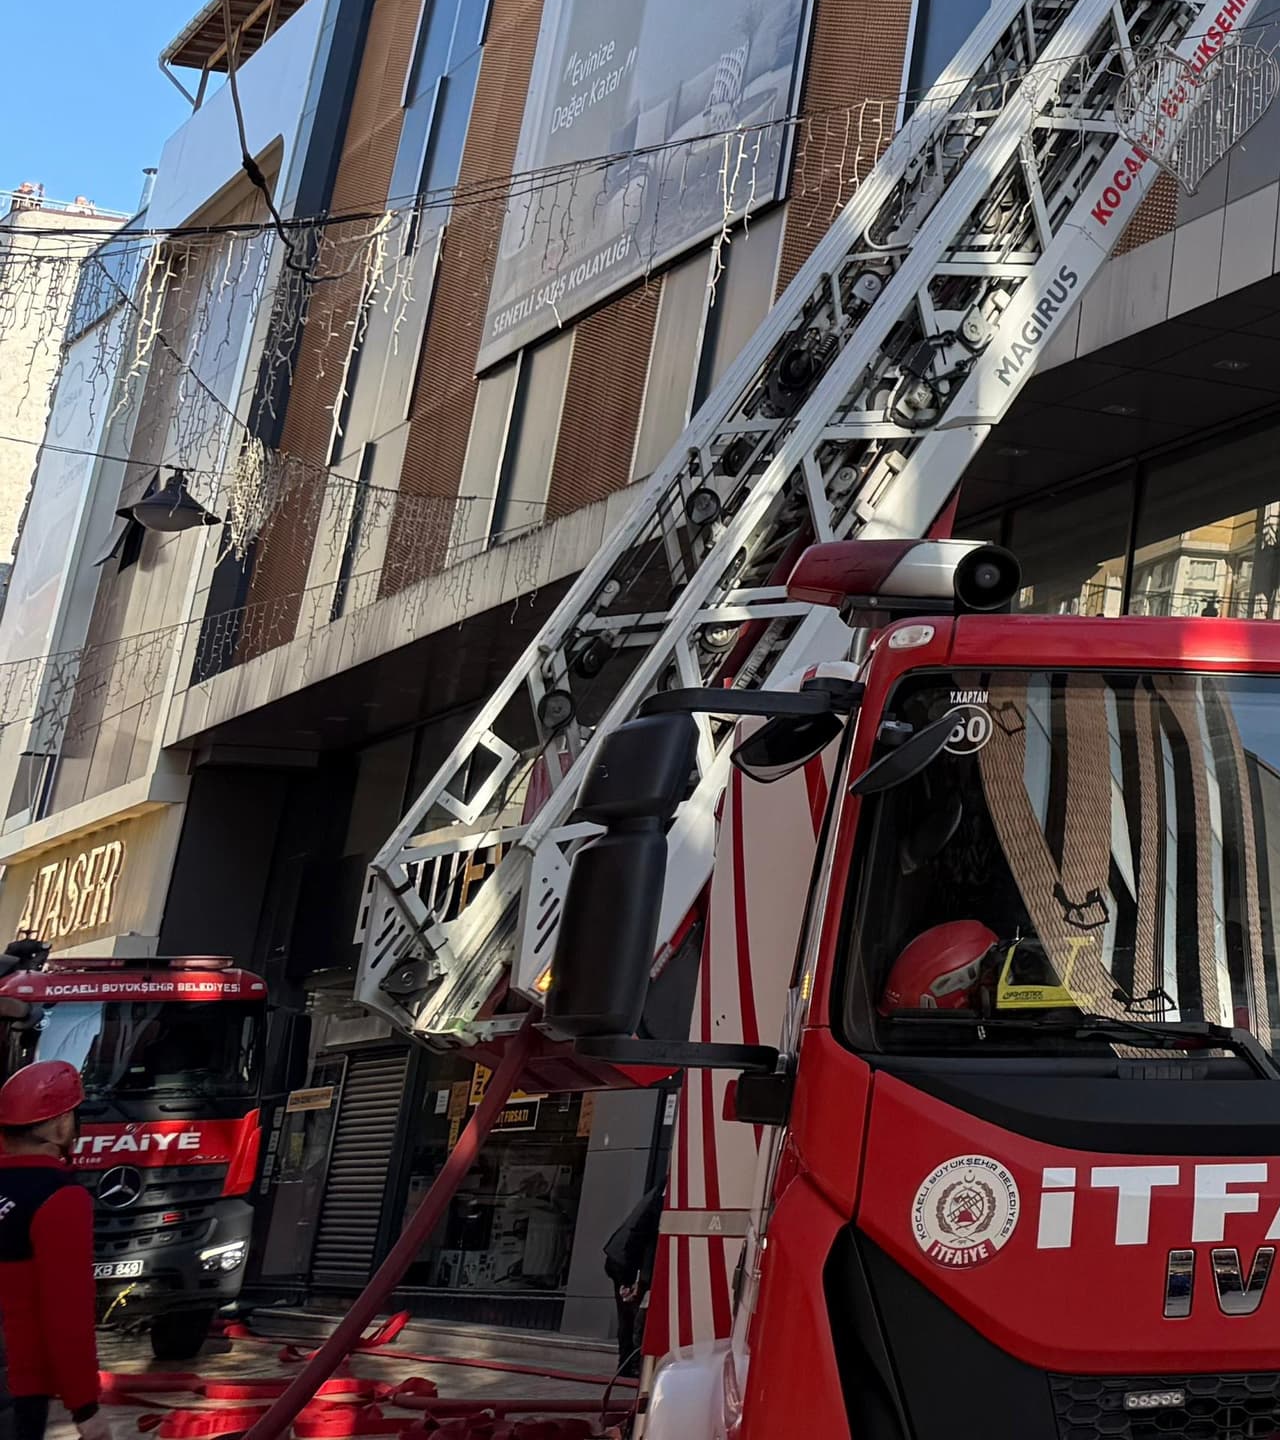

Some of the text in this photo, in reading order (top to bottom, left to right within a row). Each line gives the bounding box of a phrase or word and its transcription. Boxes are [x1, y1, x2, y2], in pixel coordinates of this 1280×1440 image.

[551, 92, 588, 134] Değer
[492, 289, 535, 337] SENETLİ
[568, 234, 632, 291] KOLAYLIĞI
[996, 264, 1079, 388] MAGIRUS
[950, 691, 989, 704] Y.KAPTAN
[45, 982, 241, 995] KOCAELİ BÜYÜKŞEHİR BELEDİYESİ
[115, 1263, 139, 1275] 849
